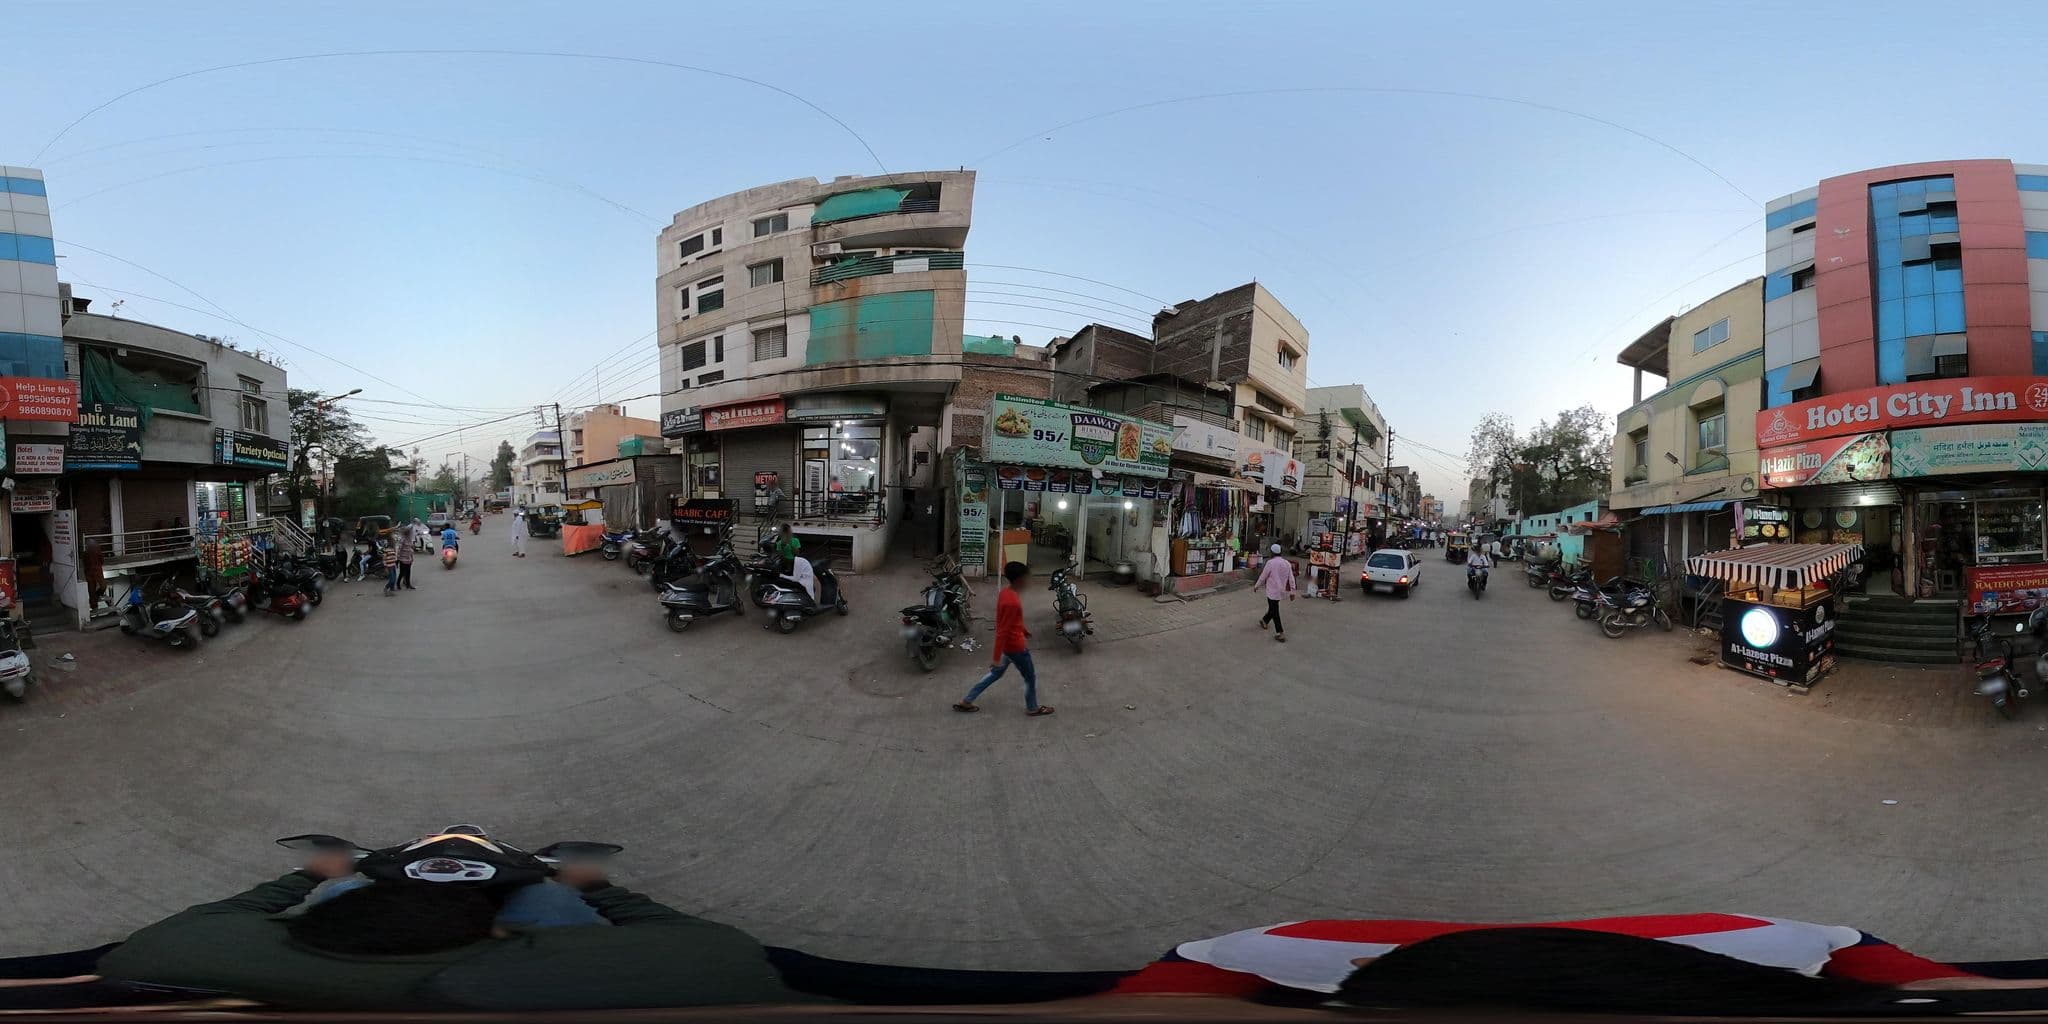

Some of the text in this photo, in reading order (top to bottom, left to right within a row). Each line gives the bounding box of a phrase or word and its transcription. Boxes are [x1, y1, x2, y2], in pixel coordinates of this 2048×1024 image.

[15, 382, 72, 394] Help Line No.
[2034, 387, 2048, 398] 24
[1003, 395, 1046, 405] Unlimited
[19, 405, 72, 417] 9860890870
[1806, 386, 2017, 430] Hotel City Inn
[109, 413, 138, 428] Land
[1074, 415, 1120, 430] DAAWAT
[1033, 429, 1069, 443] 95/-
[234, 442, 263, 459] Variety
[262, 447, 287, 461] Opticals
[1796, 452, 1822, 470] Pizza
[673, 508, 704, 518] ARABIC
[963, 508, 986, 517] 95/-
[1730, 642, 1770, 662] A1-Lazeez
